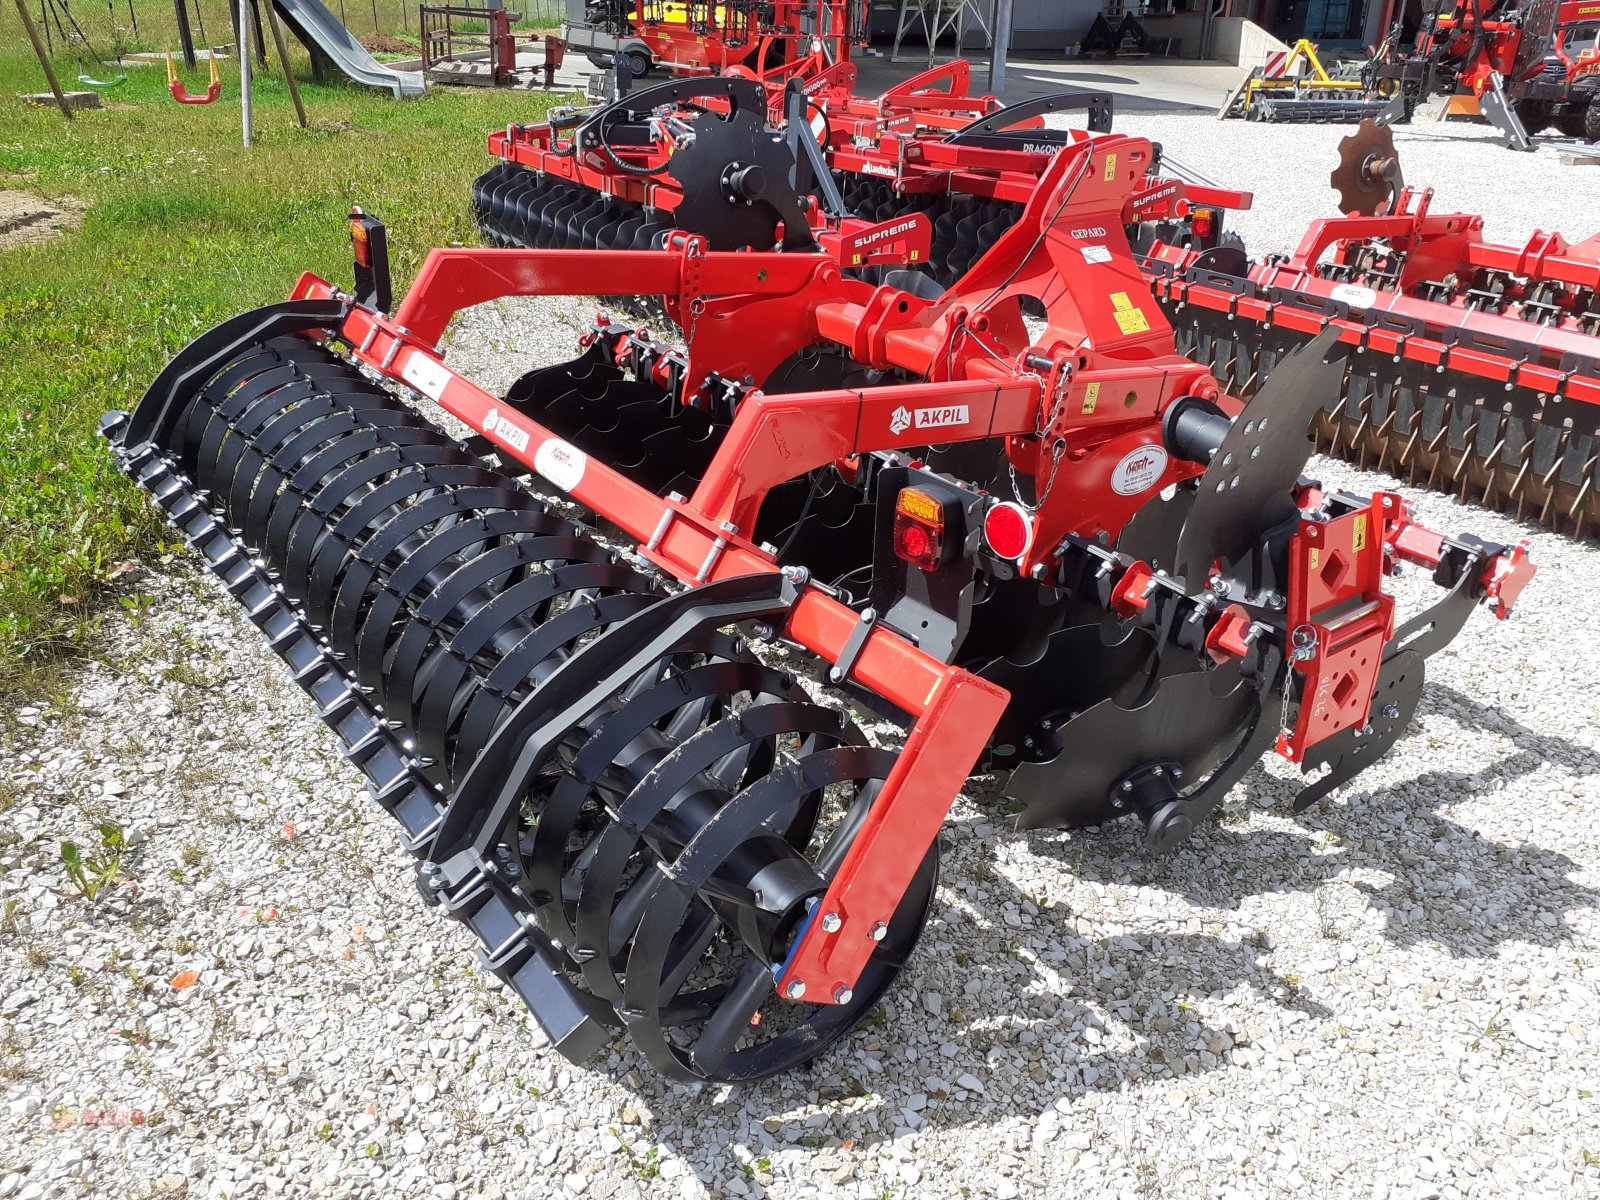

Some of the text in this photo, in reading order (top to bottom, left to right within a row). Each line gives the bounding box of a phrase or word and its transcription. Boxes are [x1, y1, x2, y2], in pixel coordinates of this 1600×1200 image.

[877, 116, 910, 130] SUREME
[1133, 186, 1177, 208] SUPREME
[854, 219, 917, 248] SUPREME
[1071, 226, 1107, 239] GEPARD
[920, 408, 963, 425] AKPIL
[498, 422, 526, 447] AKPIL
